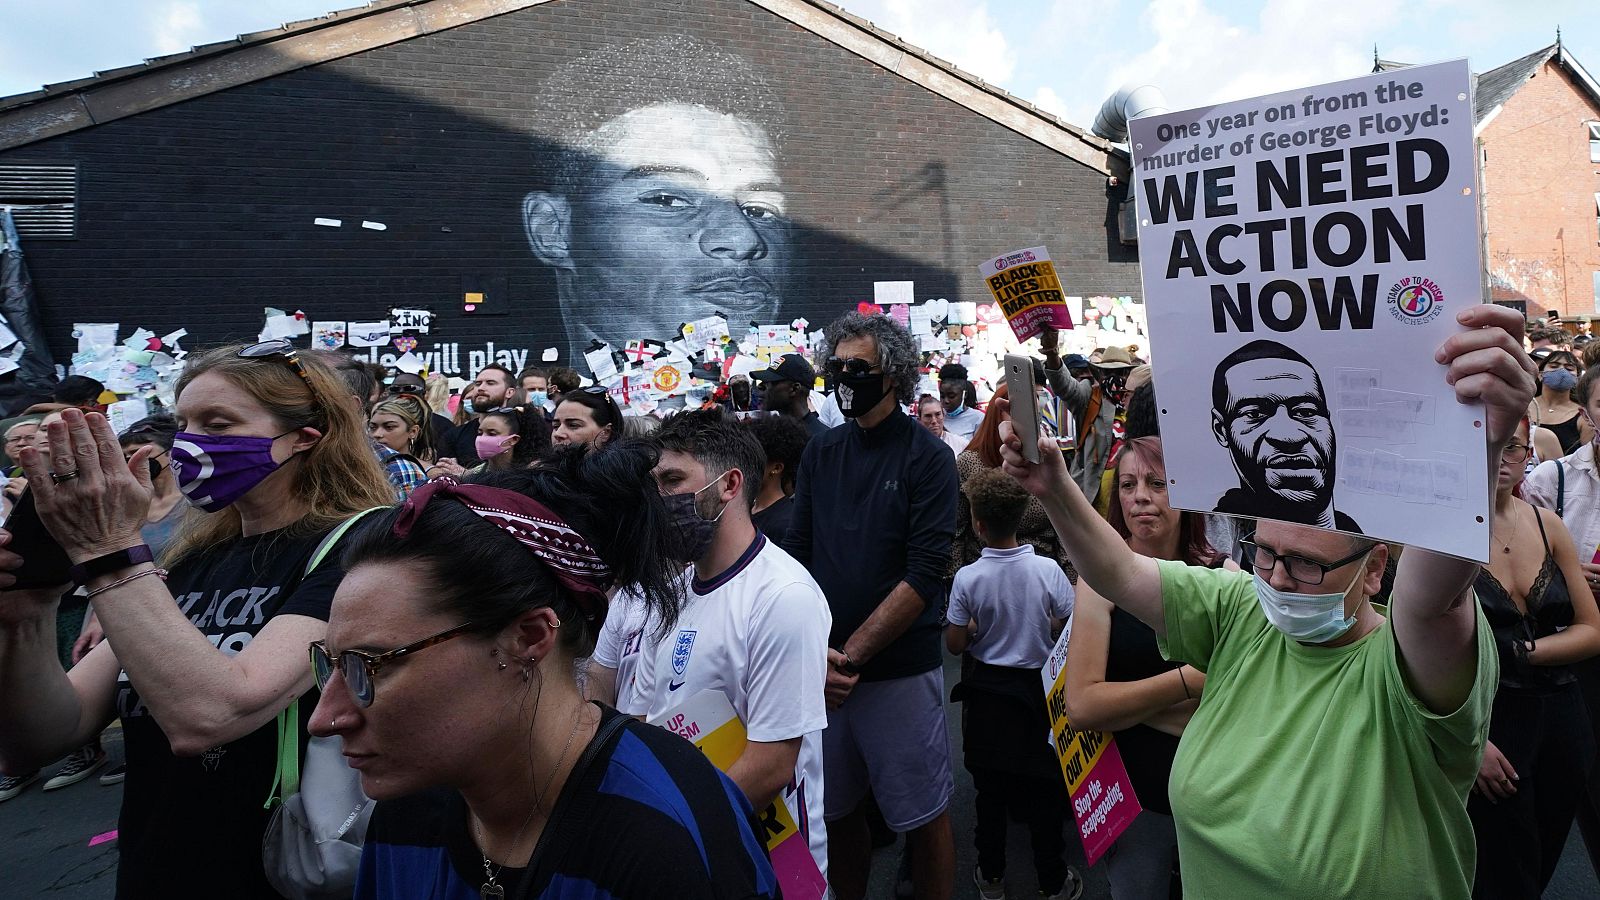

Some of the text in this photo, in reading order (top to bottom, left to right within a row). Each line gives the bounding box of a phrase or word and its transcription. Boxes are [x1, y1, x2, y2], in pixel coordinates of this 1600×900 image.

[1157, 80, 1423, 143] One year on from the
[1143, 104, 1449, 171] murder of George Floyd:
[1143, 138, 1450, 225] WE NEED
[1165, 204, 1426, 279] ACTION
[989, 263, 1042, 291] BLACK
[995, 278, 1040, 303] LIVES
[1387, 276, 1444, 304] STAND UP TO RACISM
[1002, 289, 1064, 317] MATTER
[1011, 306, 1054, 329] No justice
[1210, 274, 1379, 333] NOW
[1389, 304, 1444, 325] MANCHESTER
[1016, 315, 1054, 336] No peace
[175, 586, 281, 629] LACK
[667, 713, 685, 732] UP
[1065, 750, 1083, 786] our
[1075, 779, 1103, 818] Stop the
[1081, 780, 1124, 839] scapegoating
